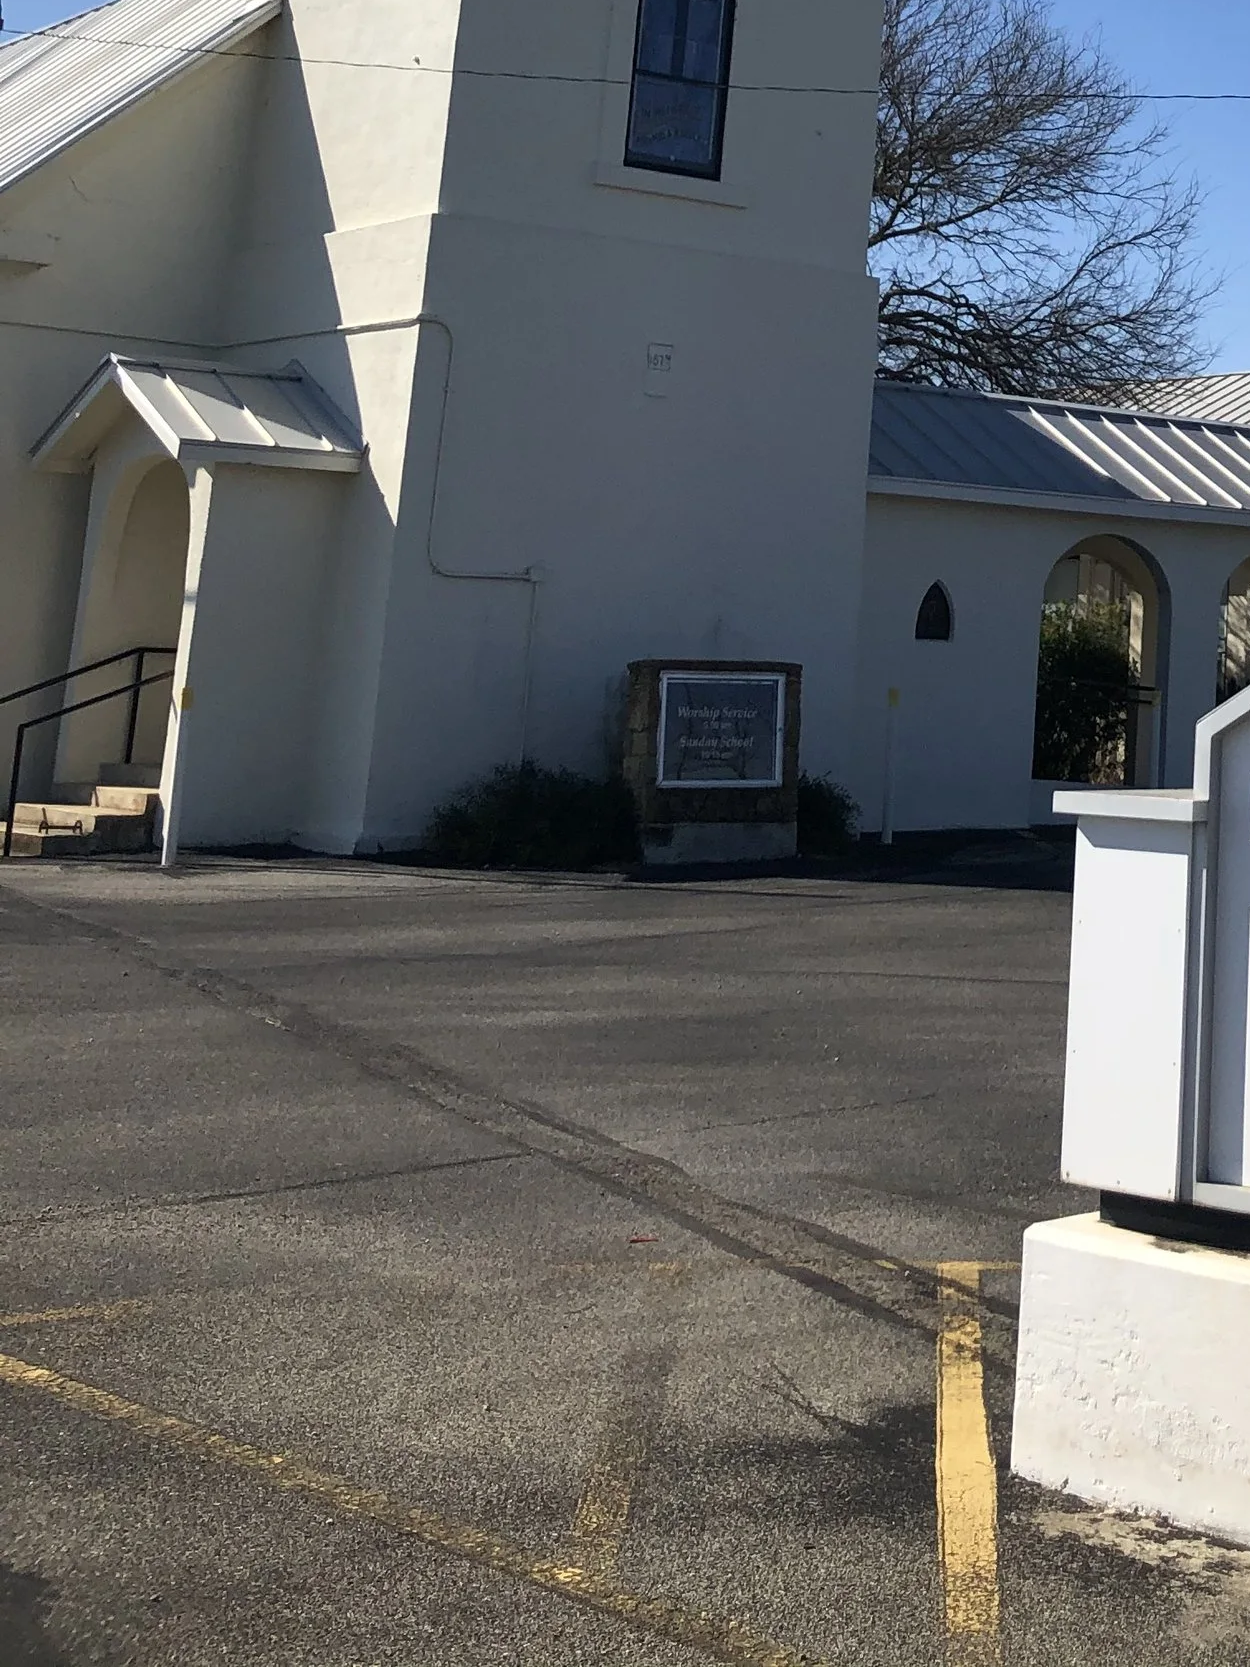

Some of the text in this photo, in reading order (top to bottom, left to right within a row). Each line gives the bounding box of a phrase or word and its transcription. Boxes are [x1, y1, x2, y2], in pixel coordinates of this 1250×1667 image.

[677, 706, 758, 720] Worship Service
[679, 735, 755, 748] Sunday School
